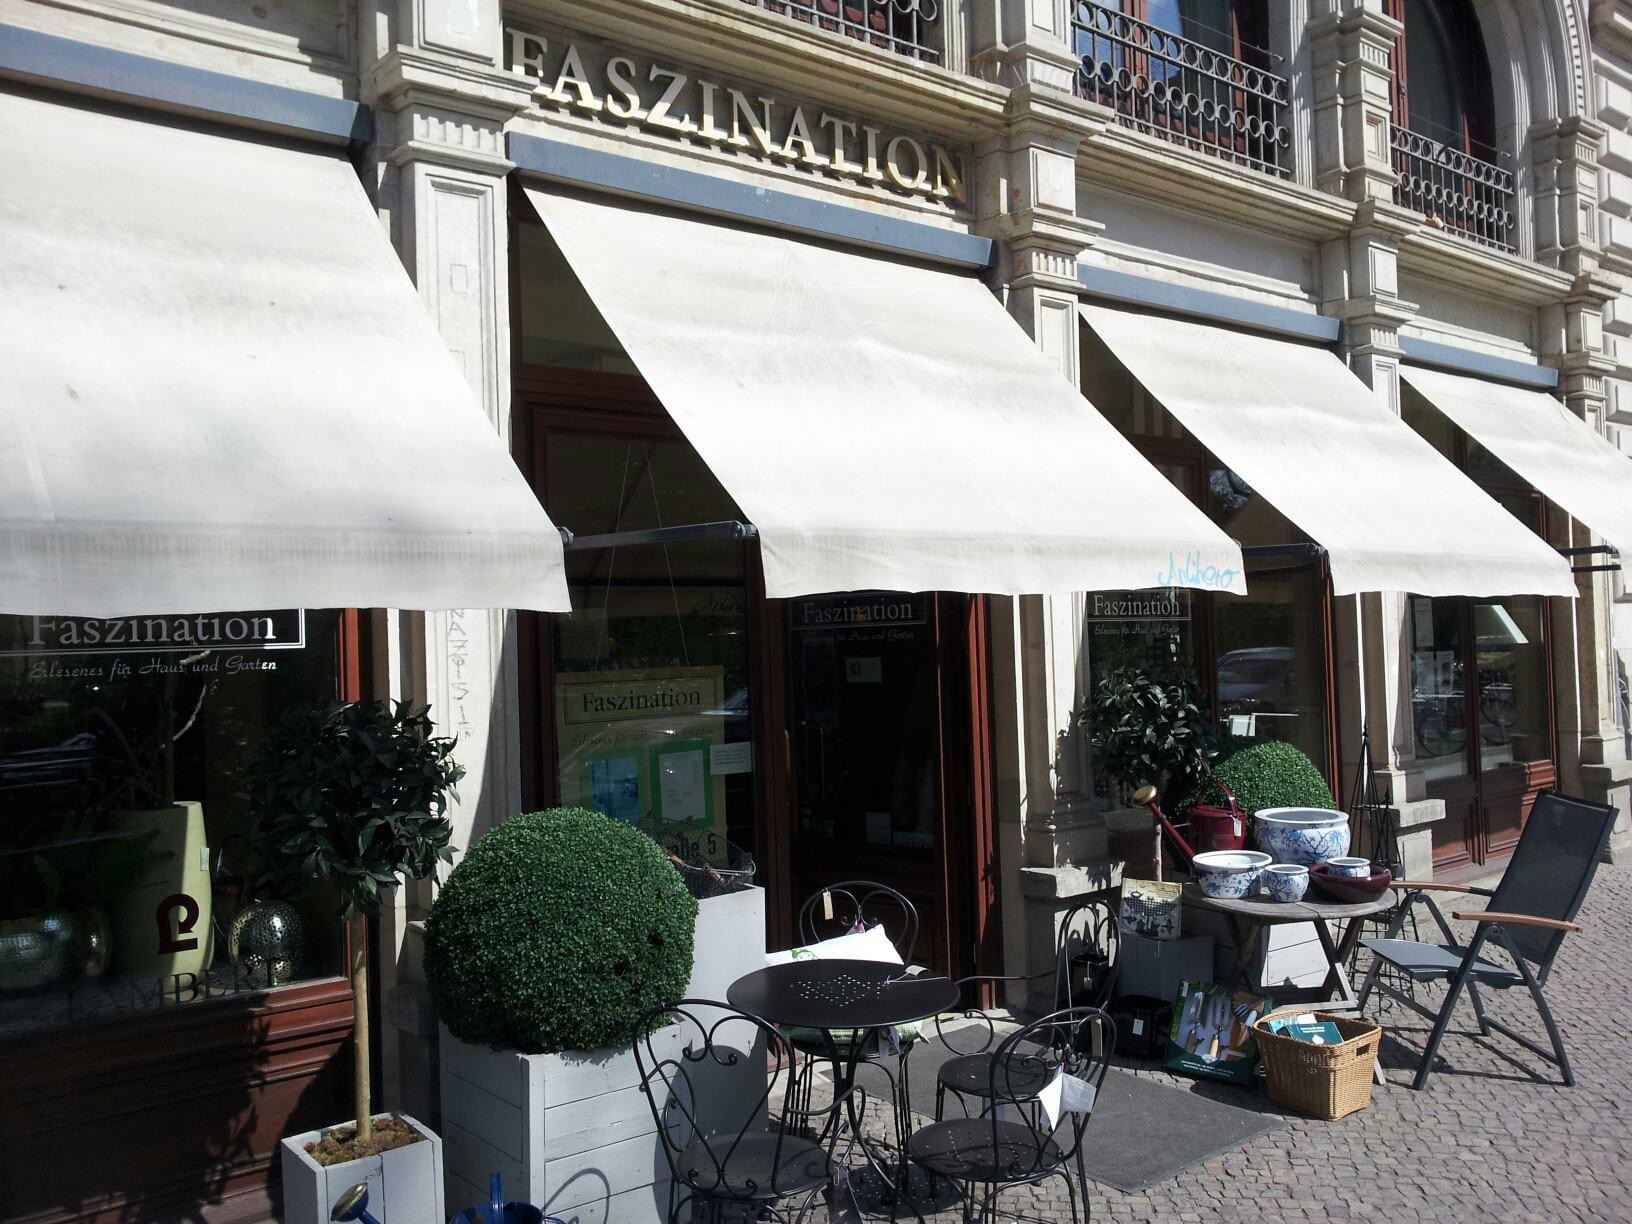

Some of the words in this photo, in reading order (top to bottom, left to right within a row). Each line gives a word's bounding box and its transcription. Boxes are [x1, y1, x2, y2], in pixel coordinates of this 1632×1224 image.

[504, 27, 966, 202] FASZINATION
[802, 597, 913, 624] Faszination
[1093, 594, 1181, 616] Faszination
[27, 612, 278, 645] Faszination
[31, 659, 104, 679] Erlesenes
[110, 658, 131, 682] für
[138, 657, 184, 674] Haus
[192, 656, 218, 673] und
[225, 656, 278, 675] Garten
[582, 688, 701, 713] Faszination
[708, 832, 717, 855] 5
